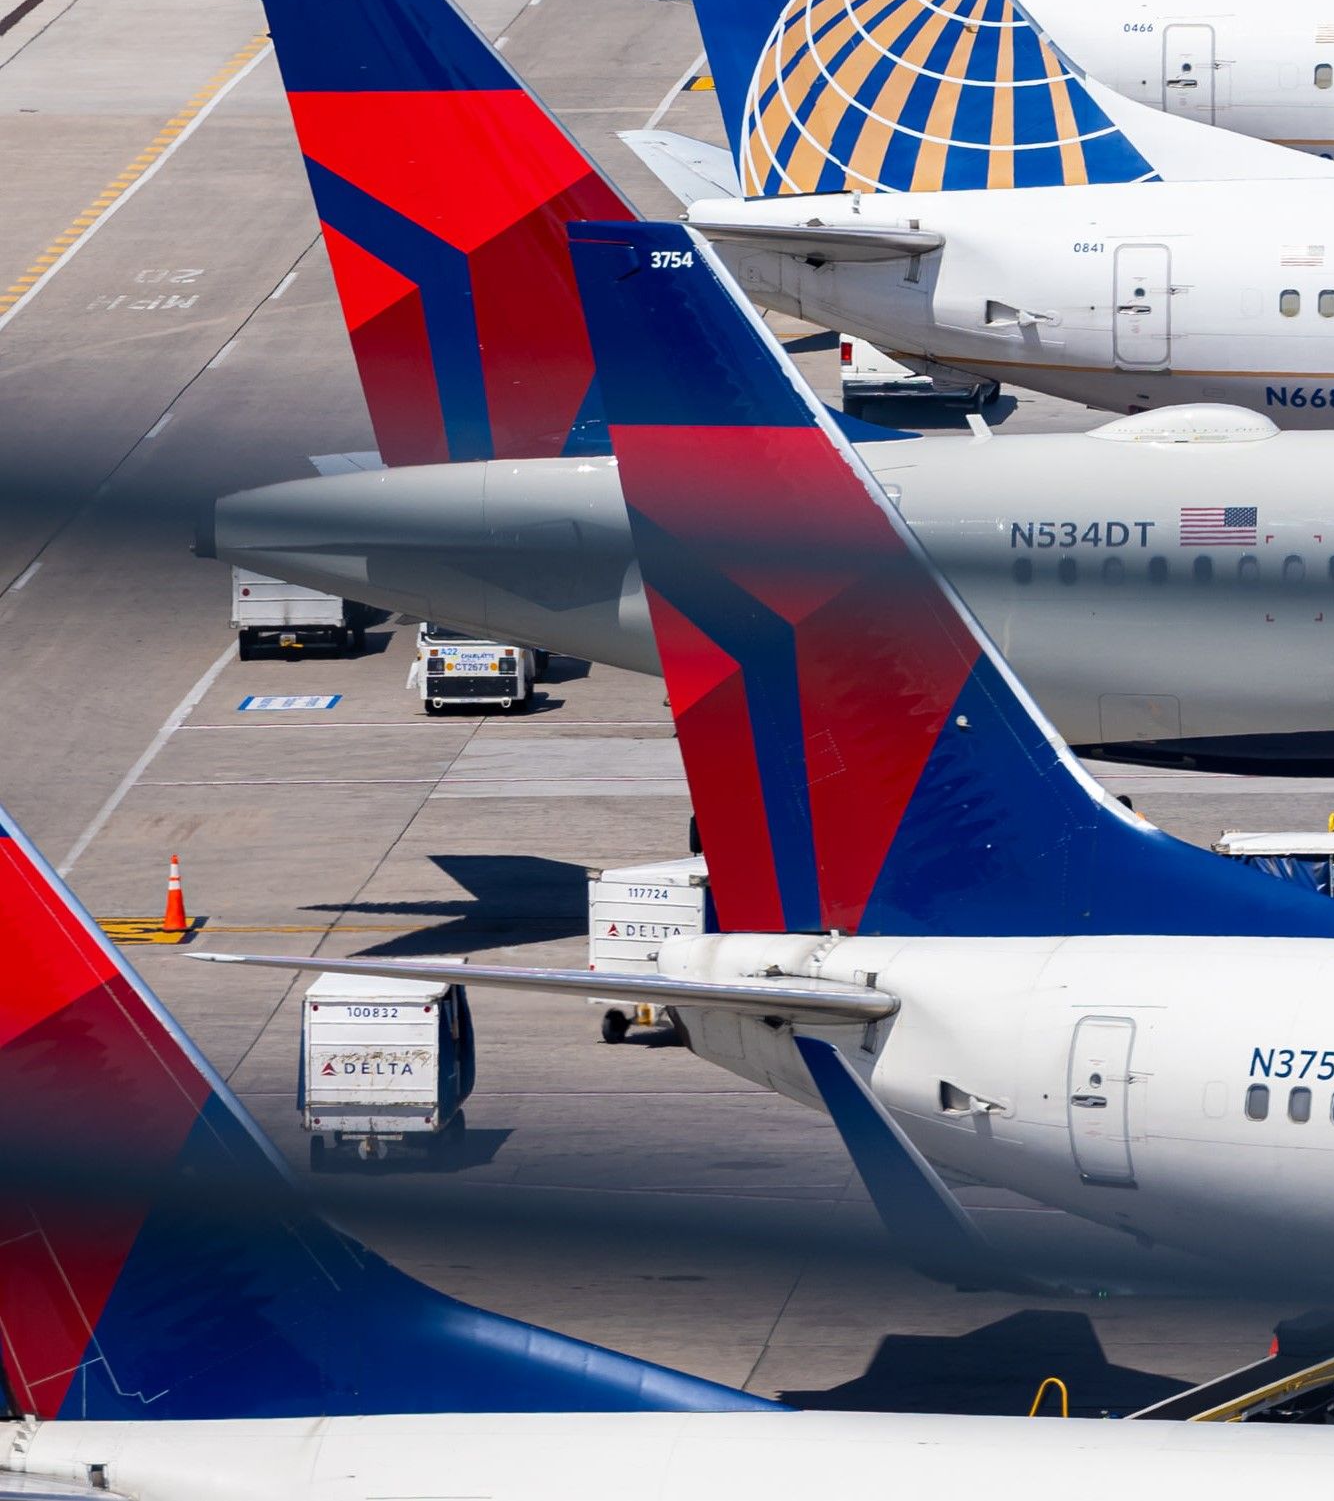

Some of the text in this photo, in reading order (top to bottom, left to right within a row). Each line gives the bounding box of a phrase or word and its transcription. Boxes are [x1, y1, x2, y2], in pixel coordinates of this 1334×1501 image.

[1123, 23, 1154, 32] 0466
[1073, 242, 1104, 253] 0841
[650, 251, 694, 269] 3754
[1010, 521, 1156, 549] N534DT
[628, 888, 669, 900] 117724
[626, 925, 681, 939] DELTA
[346, 1007, 399, 1018] 100832
[343, 1063, 413, 1075] DELTA
